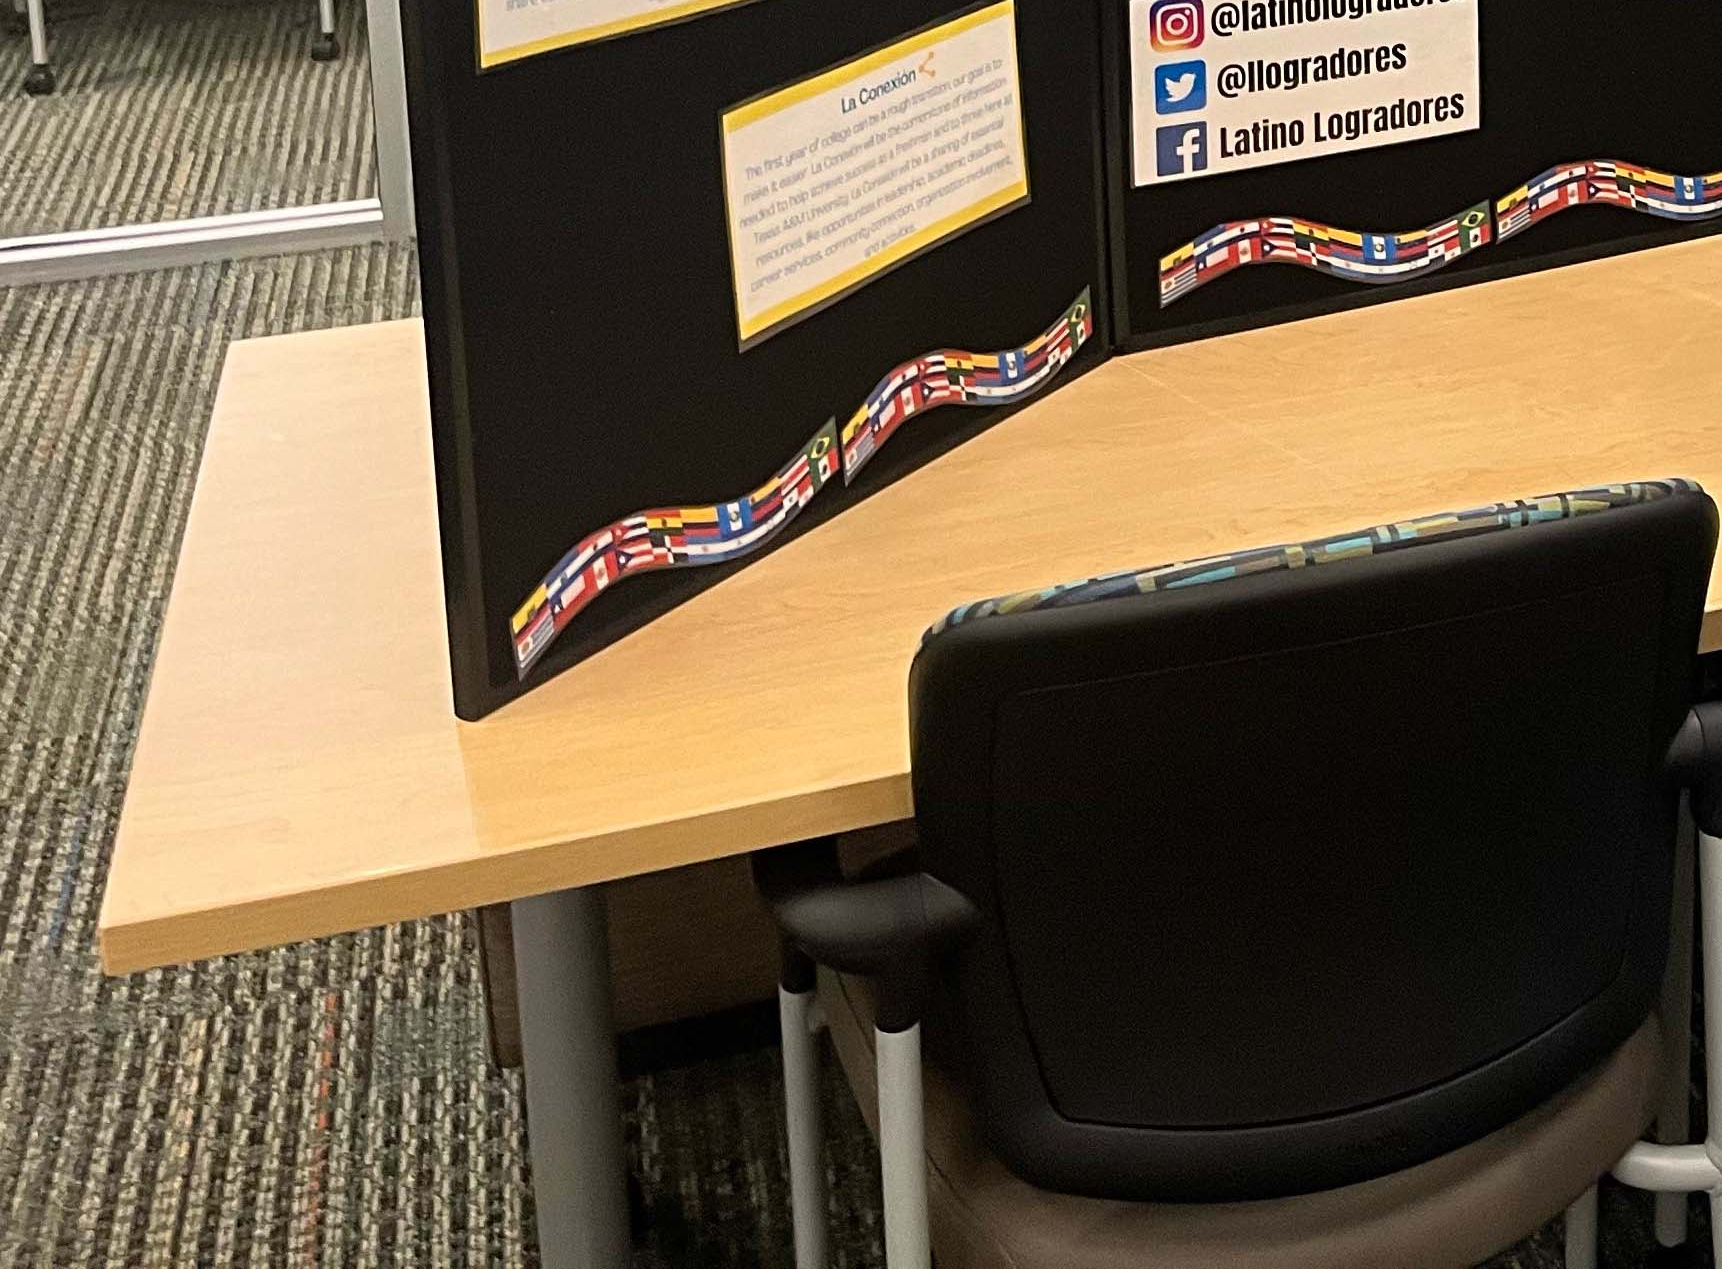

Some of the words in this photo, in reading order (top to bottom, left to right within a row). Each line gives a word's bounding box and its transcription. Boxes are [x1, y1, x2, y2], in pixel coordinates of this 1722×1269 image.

[840, 96, 857, 115] La
[858, 68, 917, 107] Conexión
[1216, 41, 1408, 99] @llogradores
[1219, 118, 1305, 159] Latino
[1313, 92, 1466, 143] Logradores
